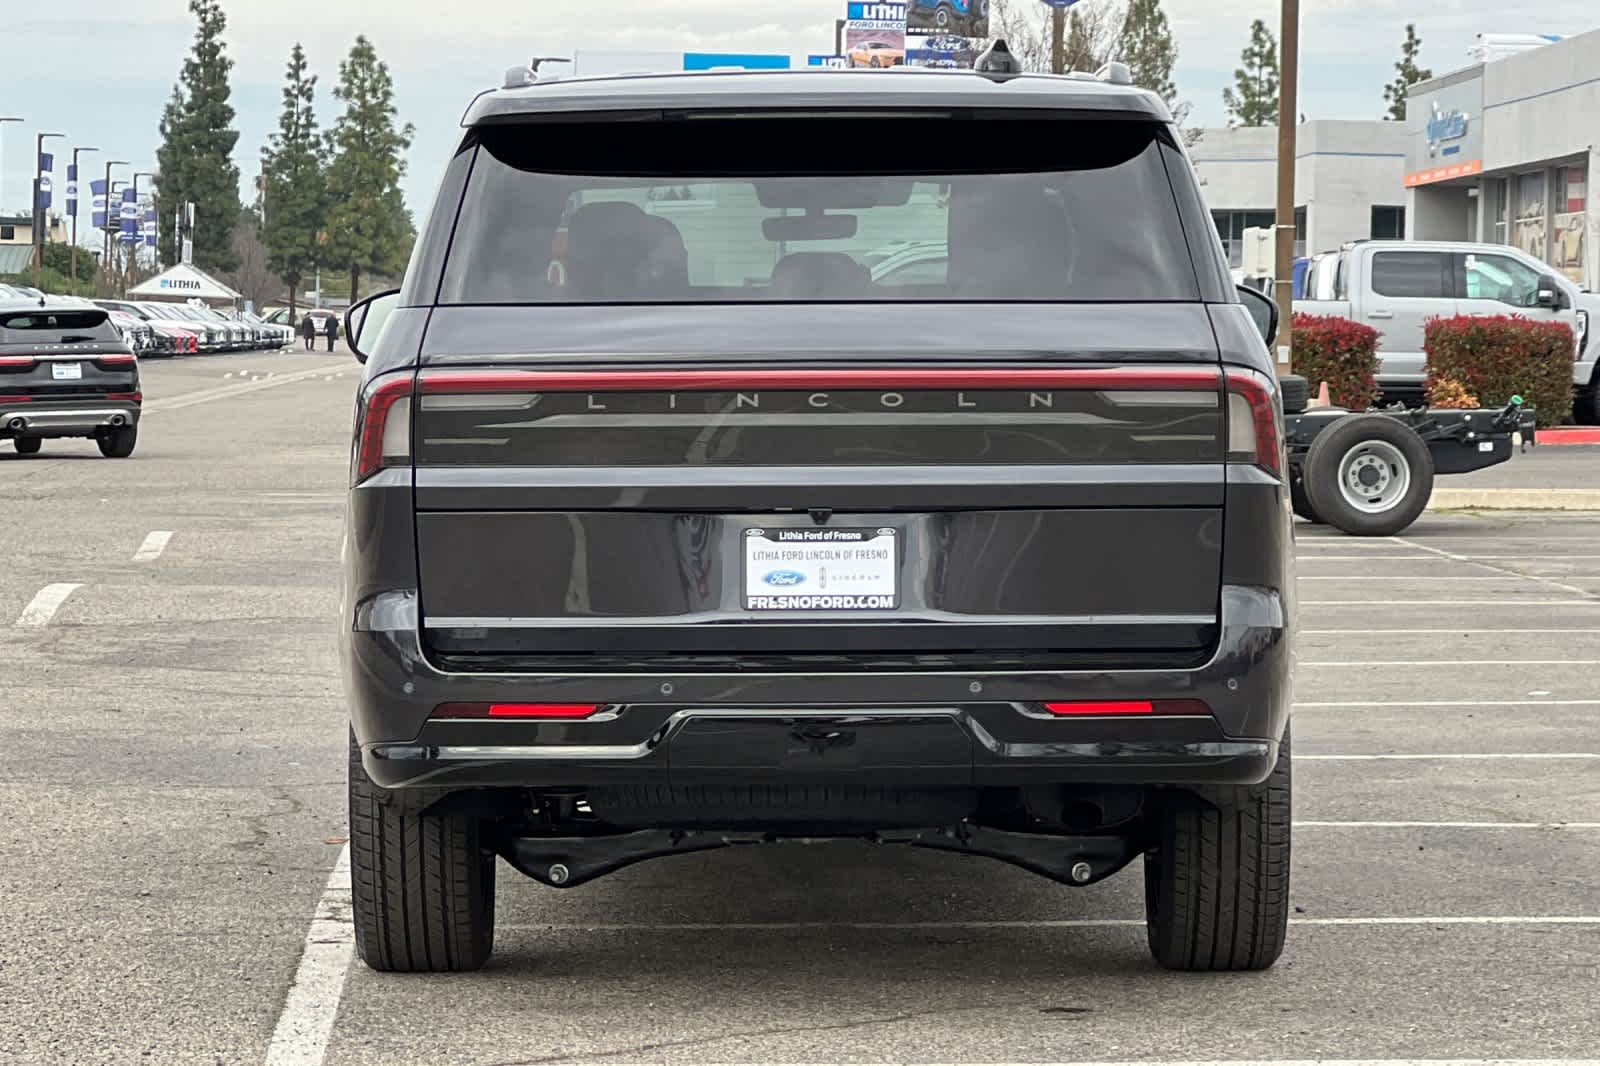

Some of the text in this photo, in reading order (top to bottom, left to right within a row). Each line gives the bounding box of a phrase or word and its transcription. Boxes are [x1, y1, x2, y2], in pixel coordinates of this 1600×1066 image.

[169, 279, 201, 289] LITHIA
[588, 393, 1053, 409] LINCOLN
[779, 531, 862, 540] Lithia Ford of Fresno
[753, 550, 888, 561] LITHIA FORD LINCOLN OF FRESNO
[769, 573, 798, 586] Ford
[748, 597, 893, 609] FRESNOFORD.COM
